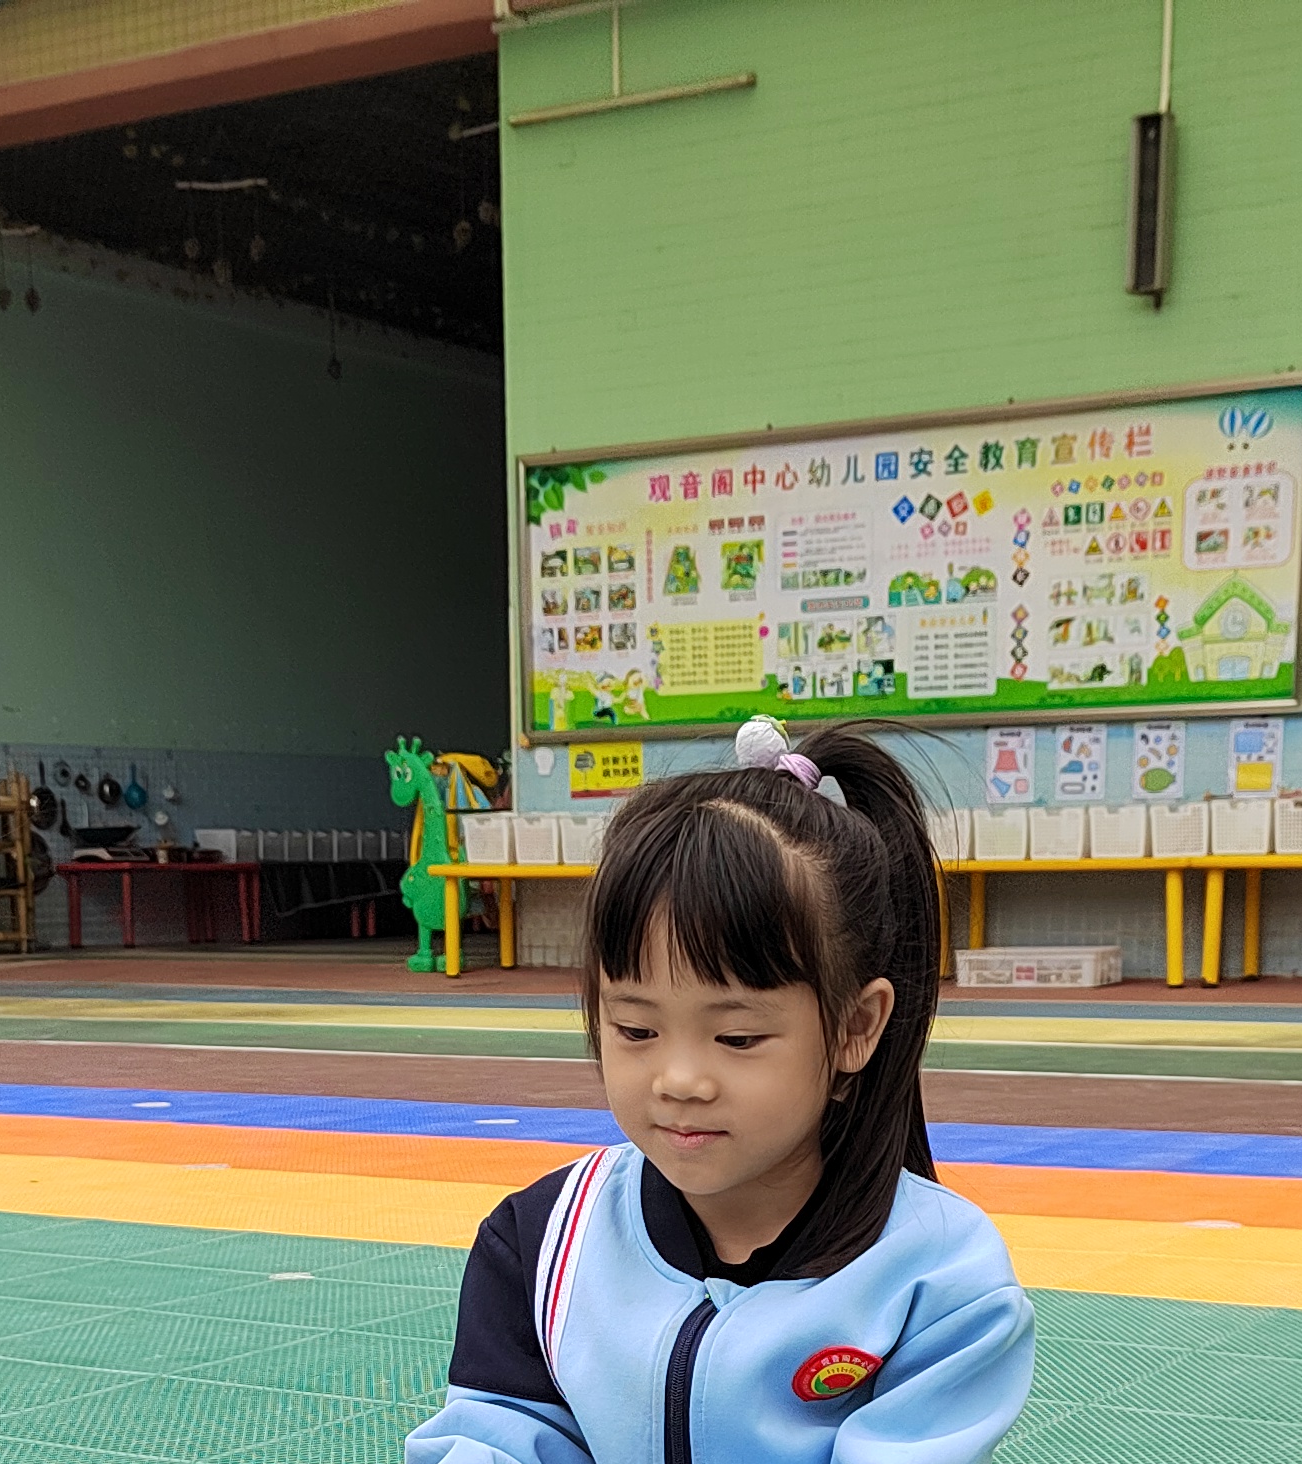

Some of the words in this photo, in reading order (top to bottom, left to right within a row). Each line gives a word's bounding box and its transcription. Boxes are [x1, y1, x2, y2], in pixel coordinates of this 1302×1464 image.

[647, 424, 1154, 503] 观音阁中心幼儿园安全教育宣传栏
